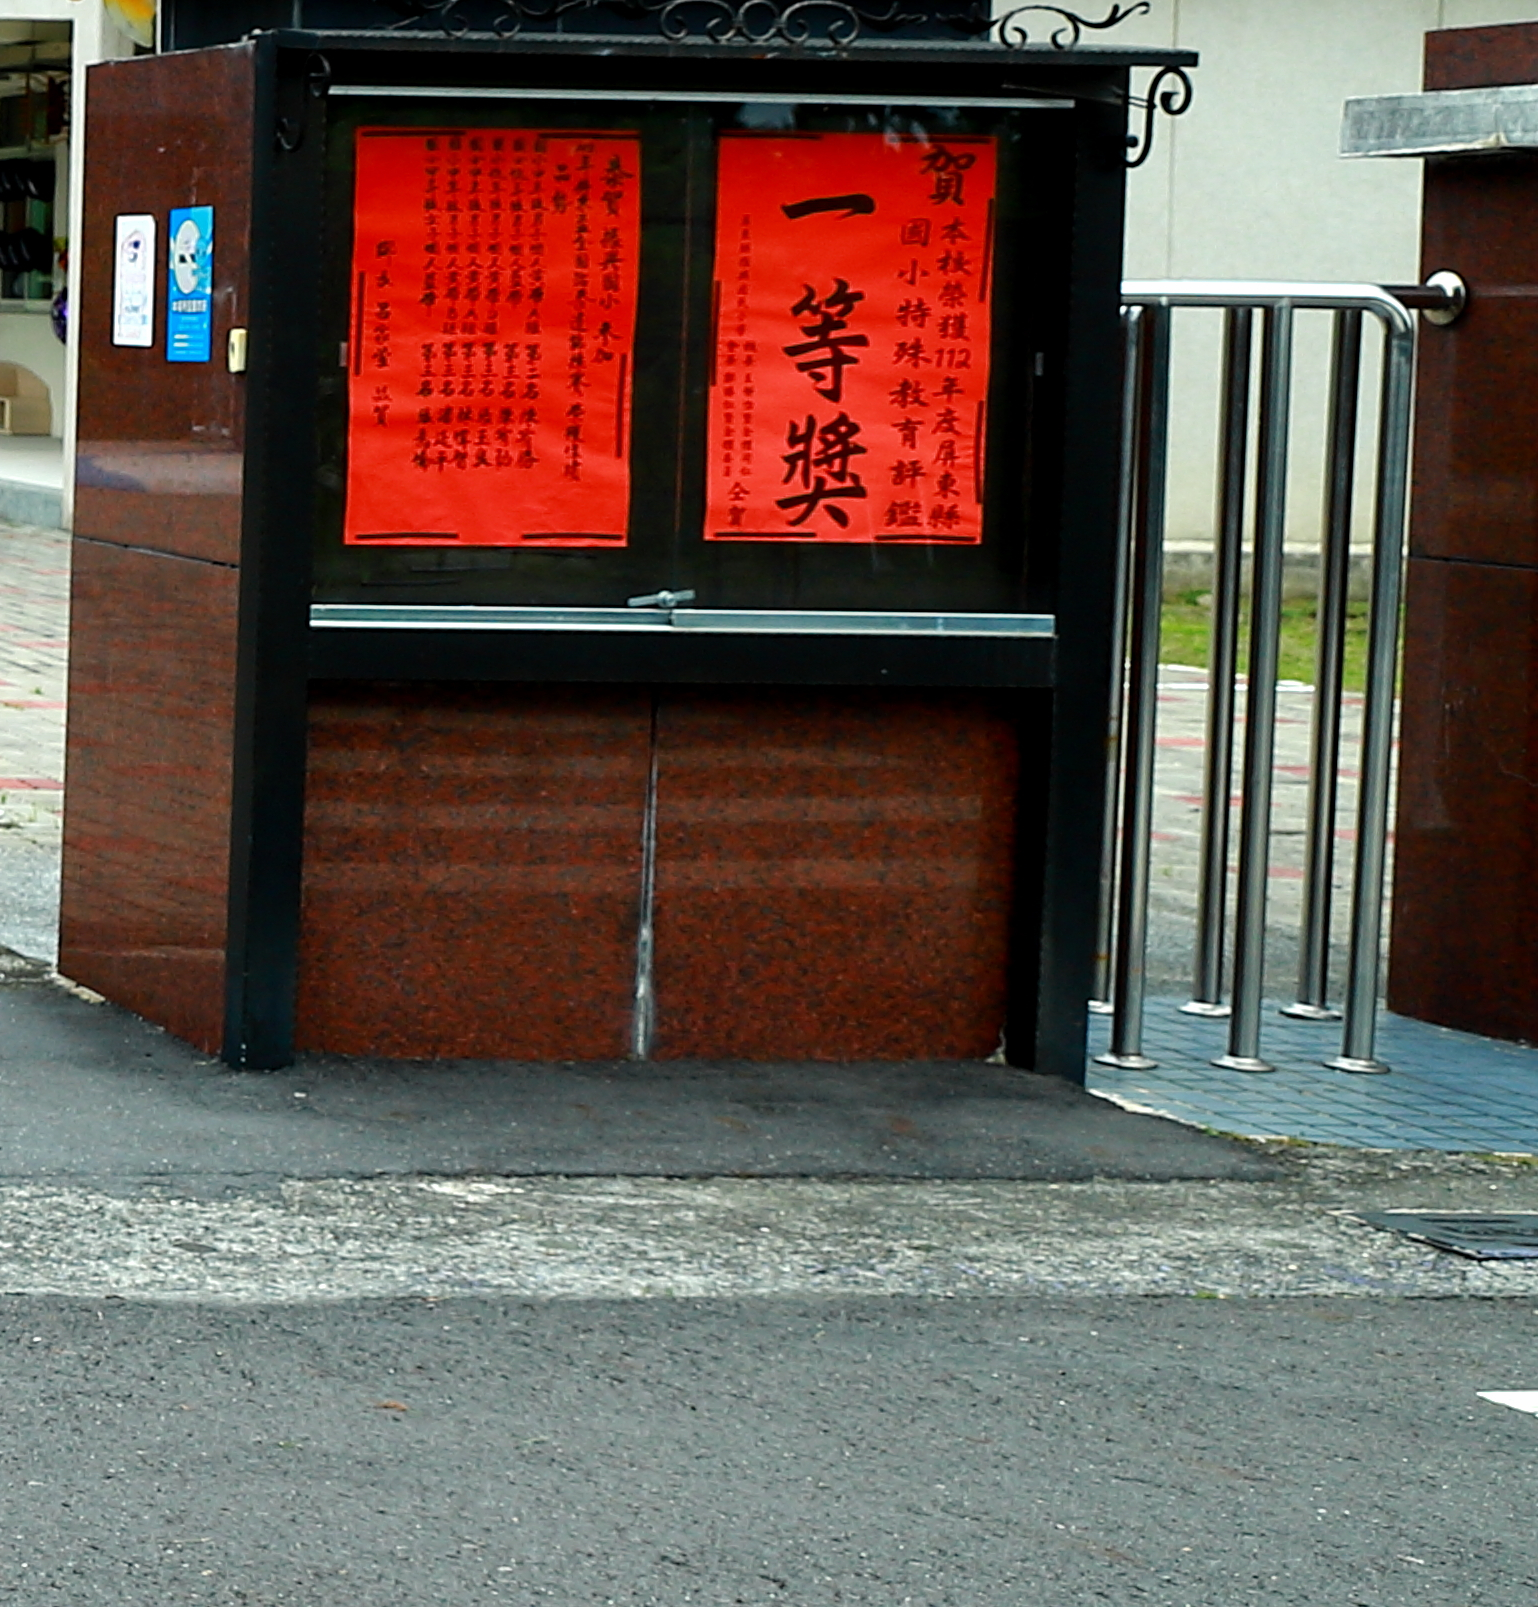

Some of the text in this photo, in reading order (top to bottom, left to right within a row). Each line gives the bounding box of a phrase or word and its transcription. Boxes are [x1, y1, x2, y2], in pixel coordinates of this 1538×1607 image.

[921, 144, 977, 206] 賀
[775, 192, 877, 530] 一等獎
